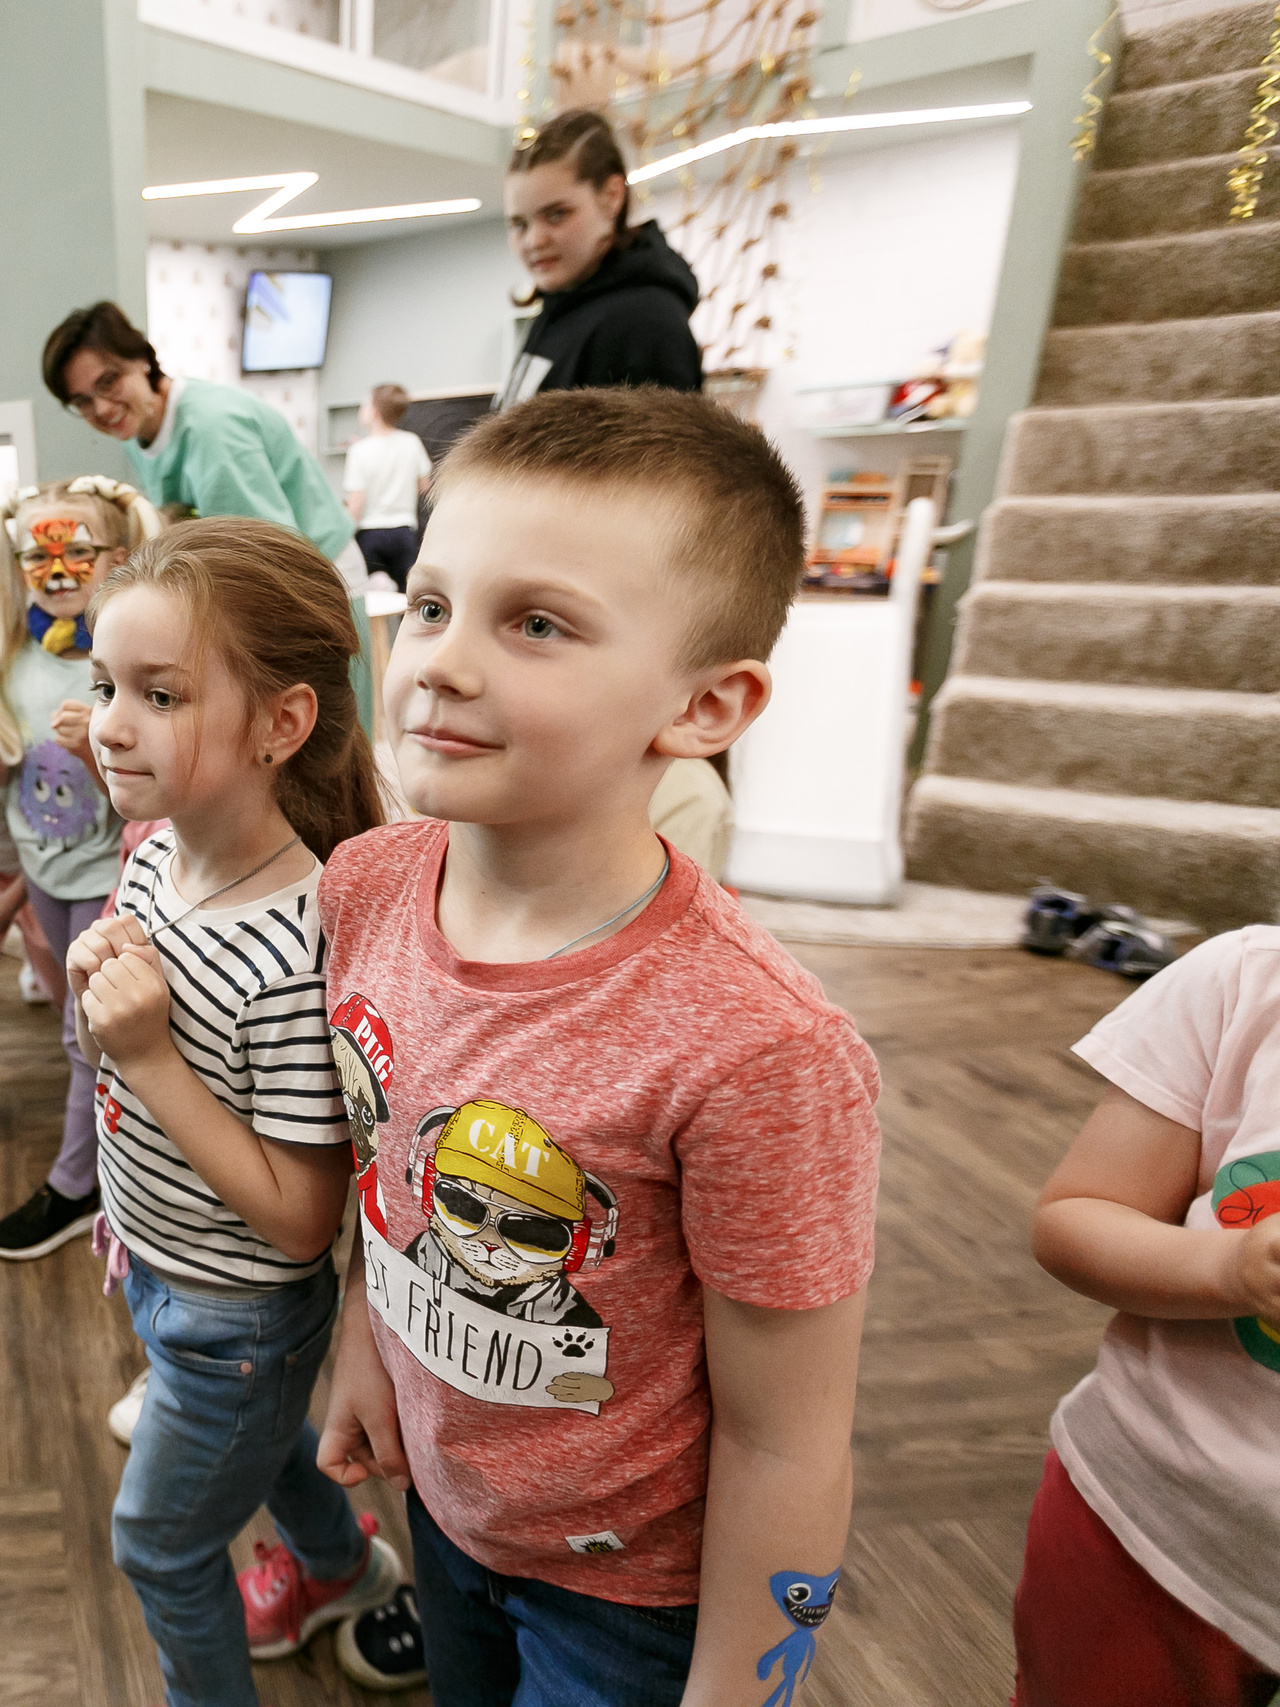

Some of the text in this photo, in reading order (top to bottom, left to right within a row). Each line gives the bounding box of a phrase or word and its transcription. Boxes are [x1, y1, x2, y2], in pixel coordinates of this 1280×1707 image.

[353, 1014, 394, 1083] PUG
[468, 1118, 550, 1178] CAT
[362, 1239, 543, 1391] ST FRIEND
